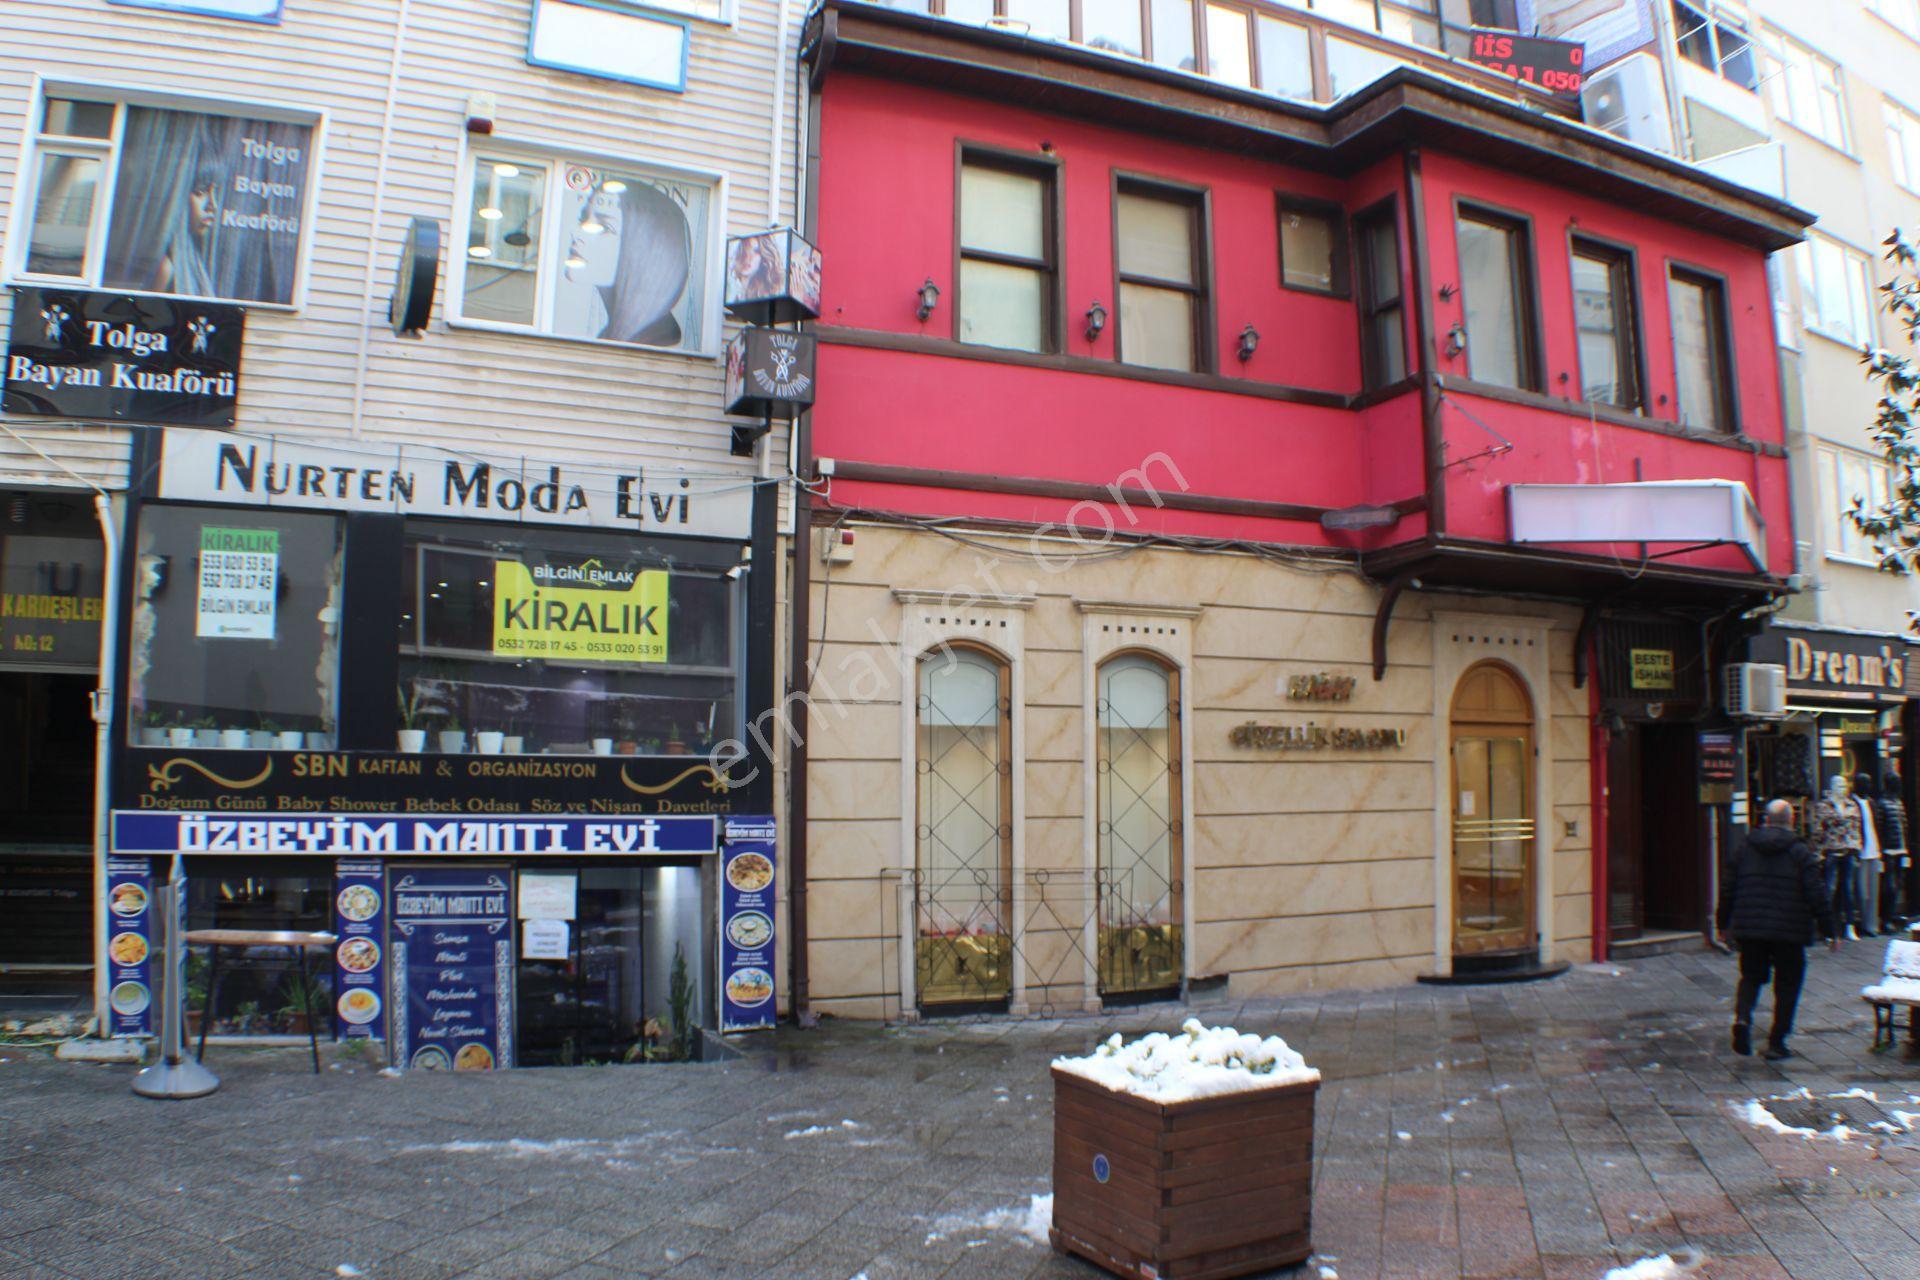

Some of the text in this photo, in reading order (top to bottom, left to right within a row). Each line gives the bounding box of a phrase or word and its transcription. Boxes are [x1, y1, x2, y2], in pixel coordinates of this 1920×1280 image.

[240, 137, 300, 165] Tolga
[234, 175, 296, 199] Bayan
[86, 320, 168, 356] Tolga
[8, 355, 235, 397] Bayan Kuaförü
[534, 564, 633, 583] BİLGİN EMLAK
[504, 590, 659, 636] KİRALIK
[498, 638, 523, 650] 0532
[528, 639, 547, 650] 728
[550, 640, 561, 650] 17
[564, 641, 577, 651] 45
[586, 642, 612, 653] 0533
[615, 643, 635, 654] 020
[638, 644, 650, 654] 53
[652, 645, 663, 655] 91
[1785, 636, 1904, 688] Dream's
[292, 753, 597, 778] SBN KAFTAN & ORGANİZASYON
[139, 793, 732, 815] Doğum Günü Baby Shower Bebek Odası Söz ve Nişan Davetleri
[178, 815, 661, 851] ÖZBEYİM MANTI EVİ
